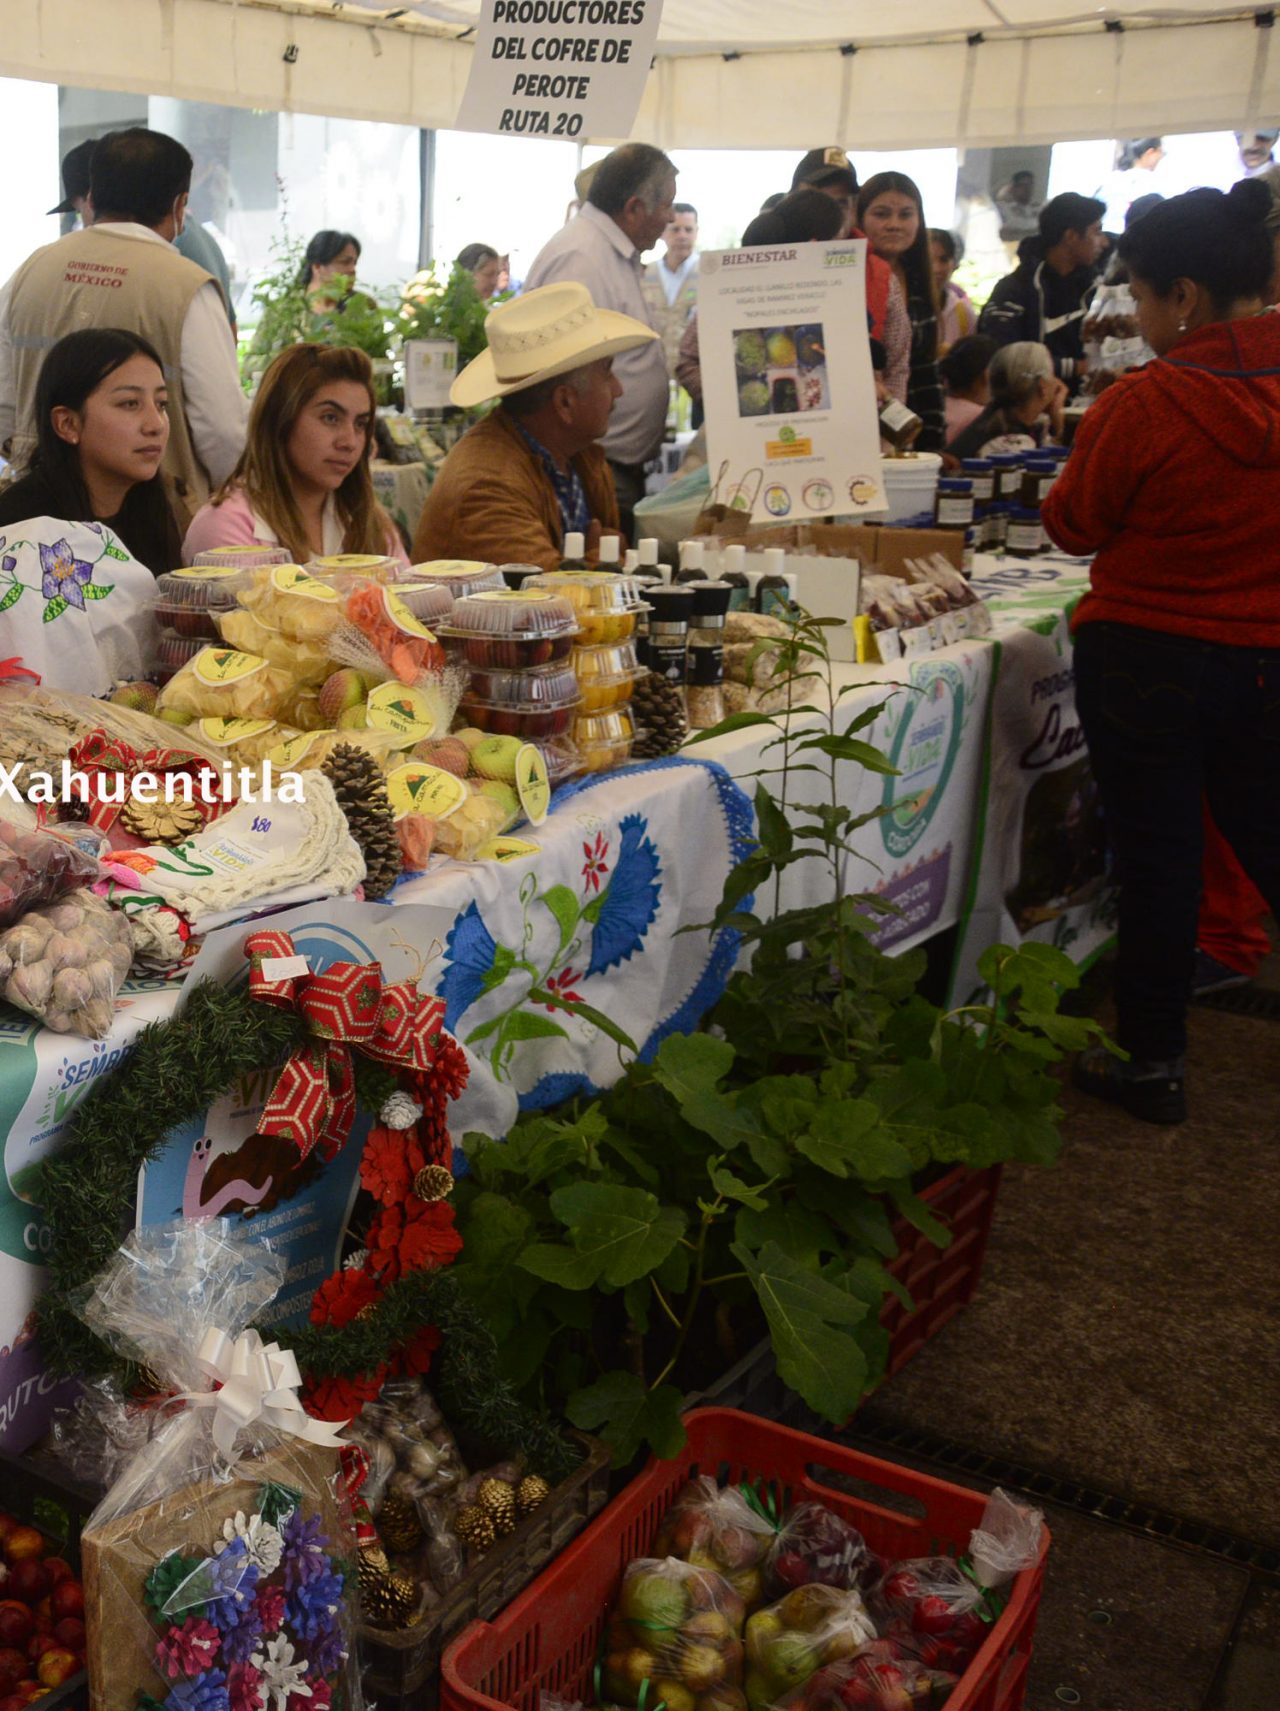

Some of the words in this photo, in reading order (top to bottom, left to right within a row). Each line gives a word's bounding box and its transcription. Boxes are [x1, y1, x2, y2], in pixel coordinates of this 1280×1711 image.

[493, 0, 646, 25] PRODUCTORES
[491, 36, 527, 60] DEL
[531, 37, 600, 62] COFRE
[601, 39, 632, 63] DE
[512, 73, 590, 100] PEROTE
[499, 108, 550, 134] RUTA
[552, 113, 583, 137] 20
[721, 249, 798, 267] BIENESTAR
[64, 272, 123, 288] MÉXICO
[114, 266, 129, 276] DE
[251, 815, 272, 833] $80
